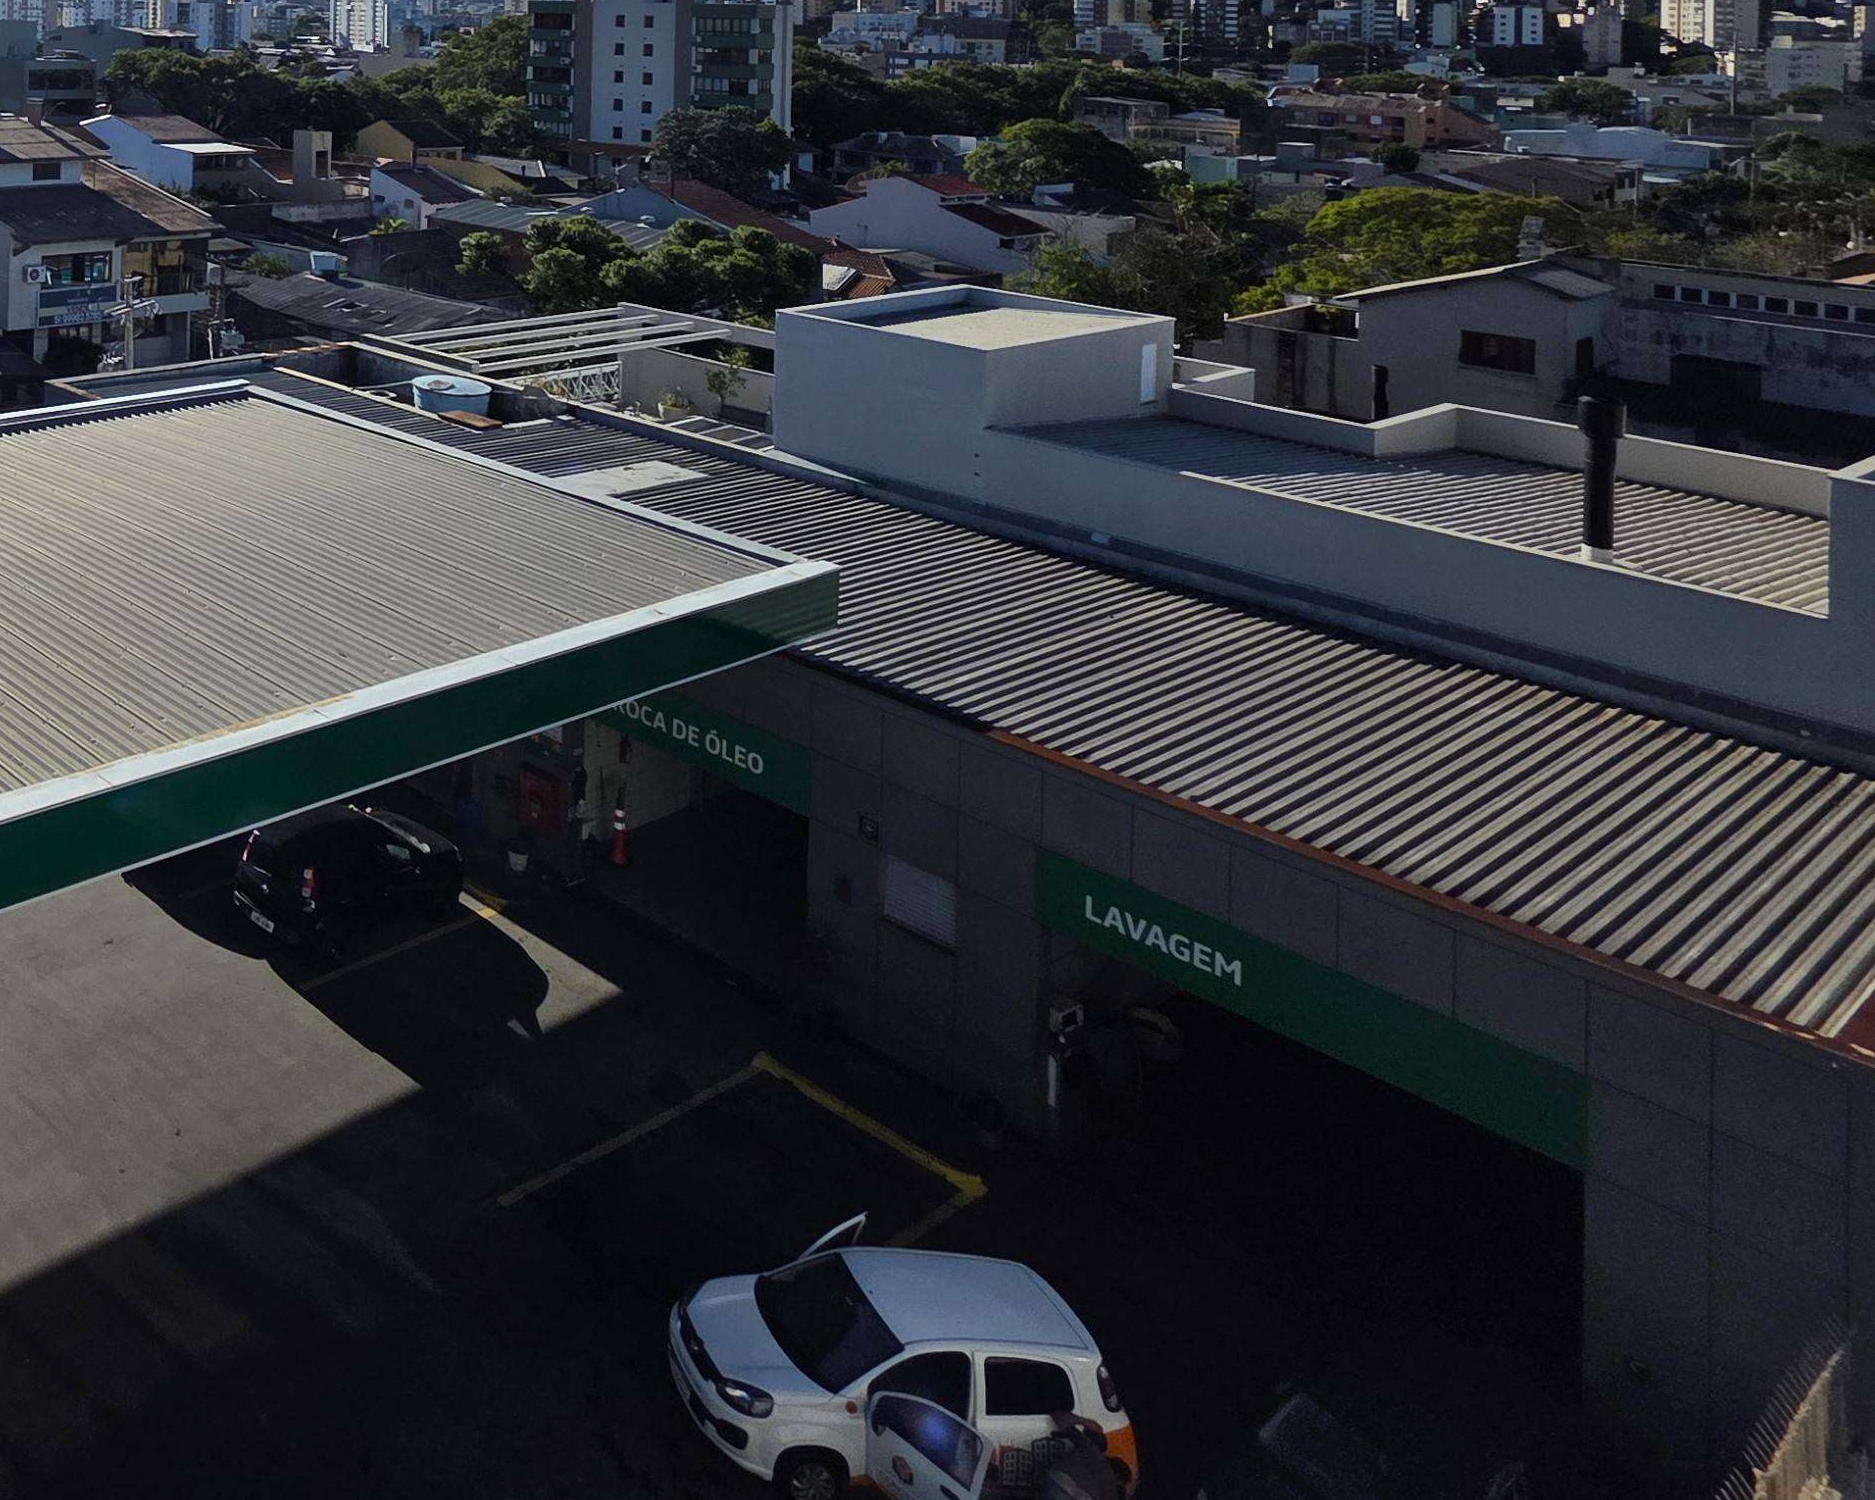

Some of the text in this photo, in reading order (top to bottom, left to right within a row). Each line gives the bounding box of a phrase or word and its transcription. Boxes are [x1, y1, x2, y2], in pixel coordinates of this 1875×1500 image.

[672, 717, 700, 748] DE
[704, 729, 765, 775] ÓLEO
[1085, 894, 1242, 987] LAVAGEM
